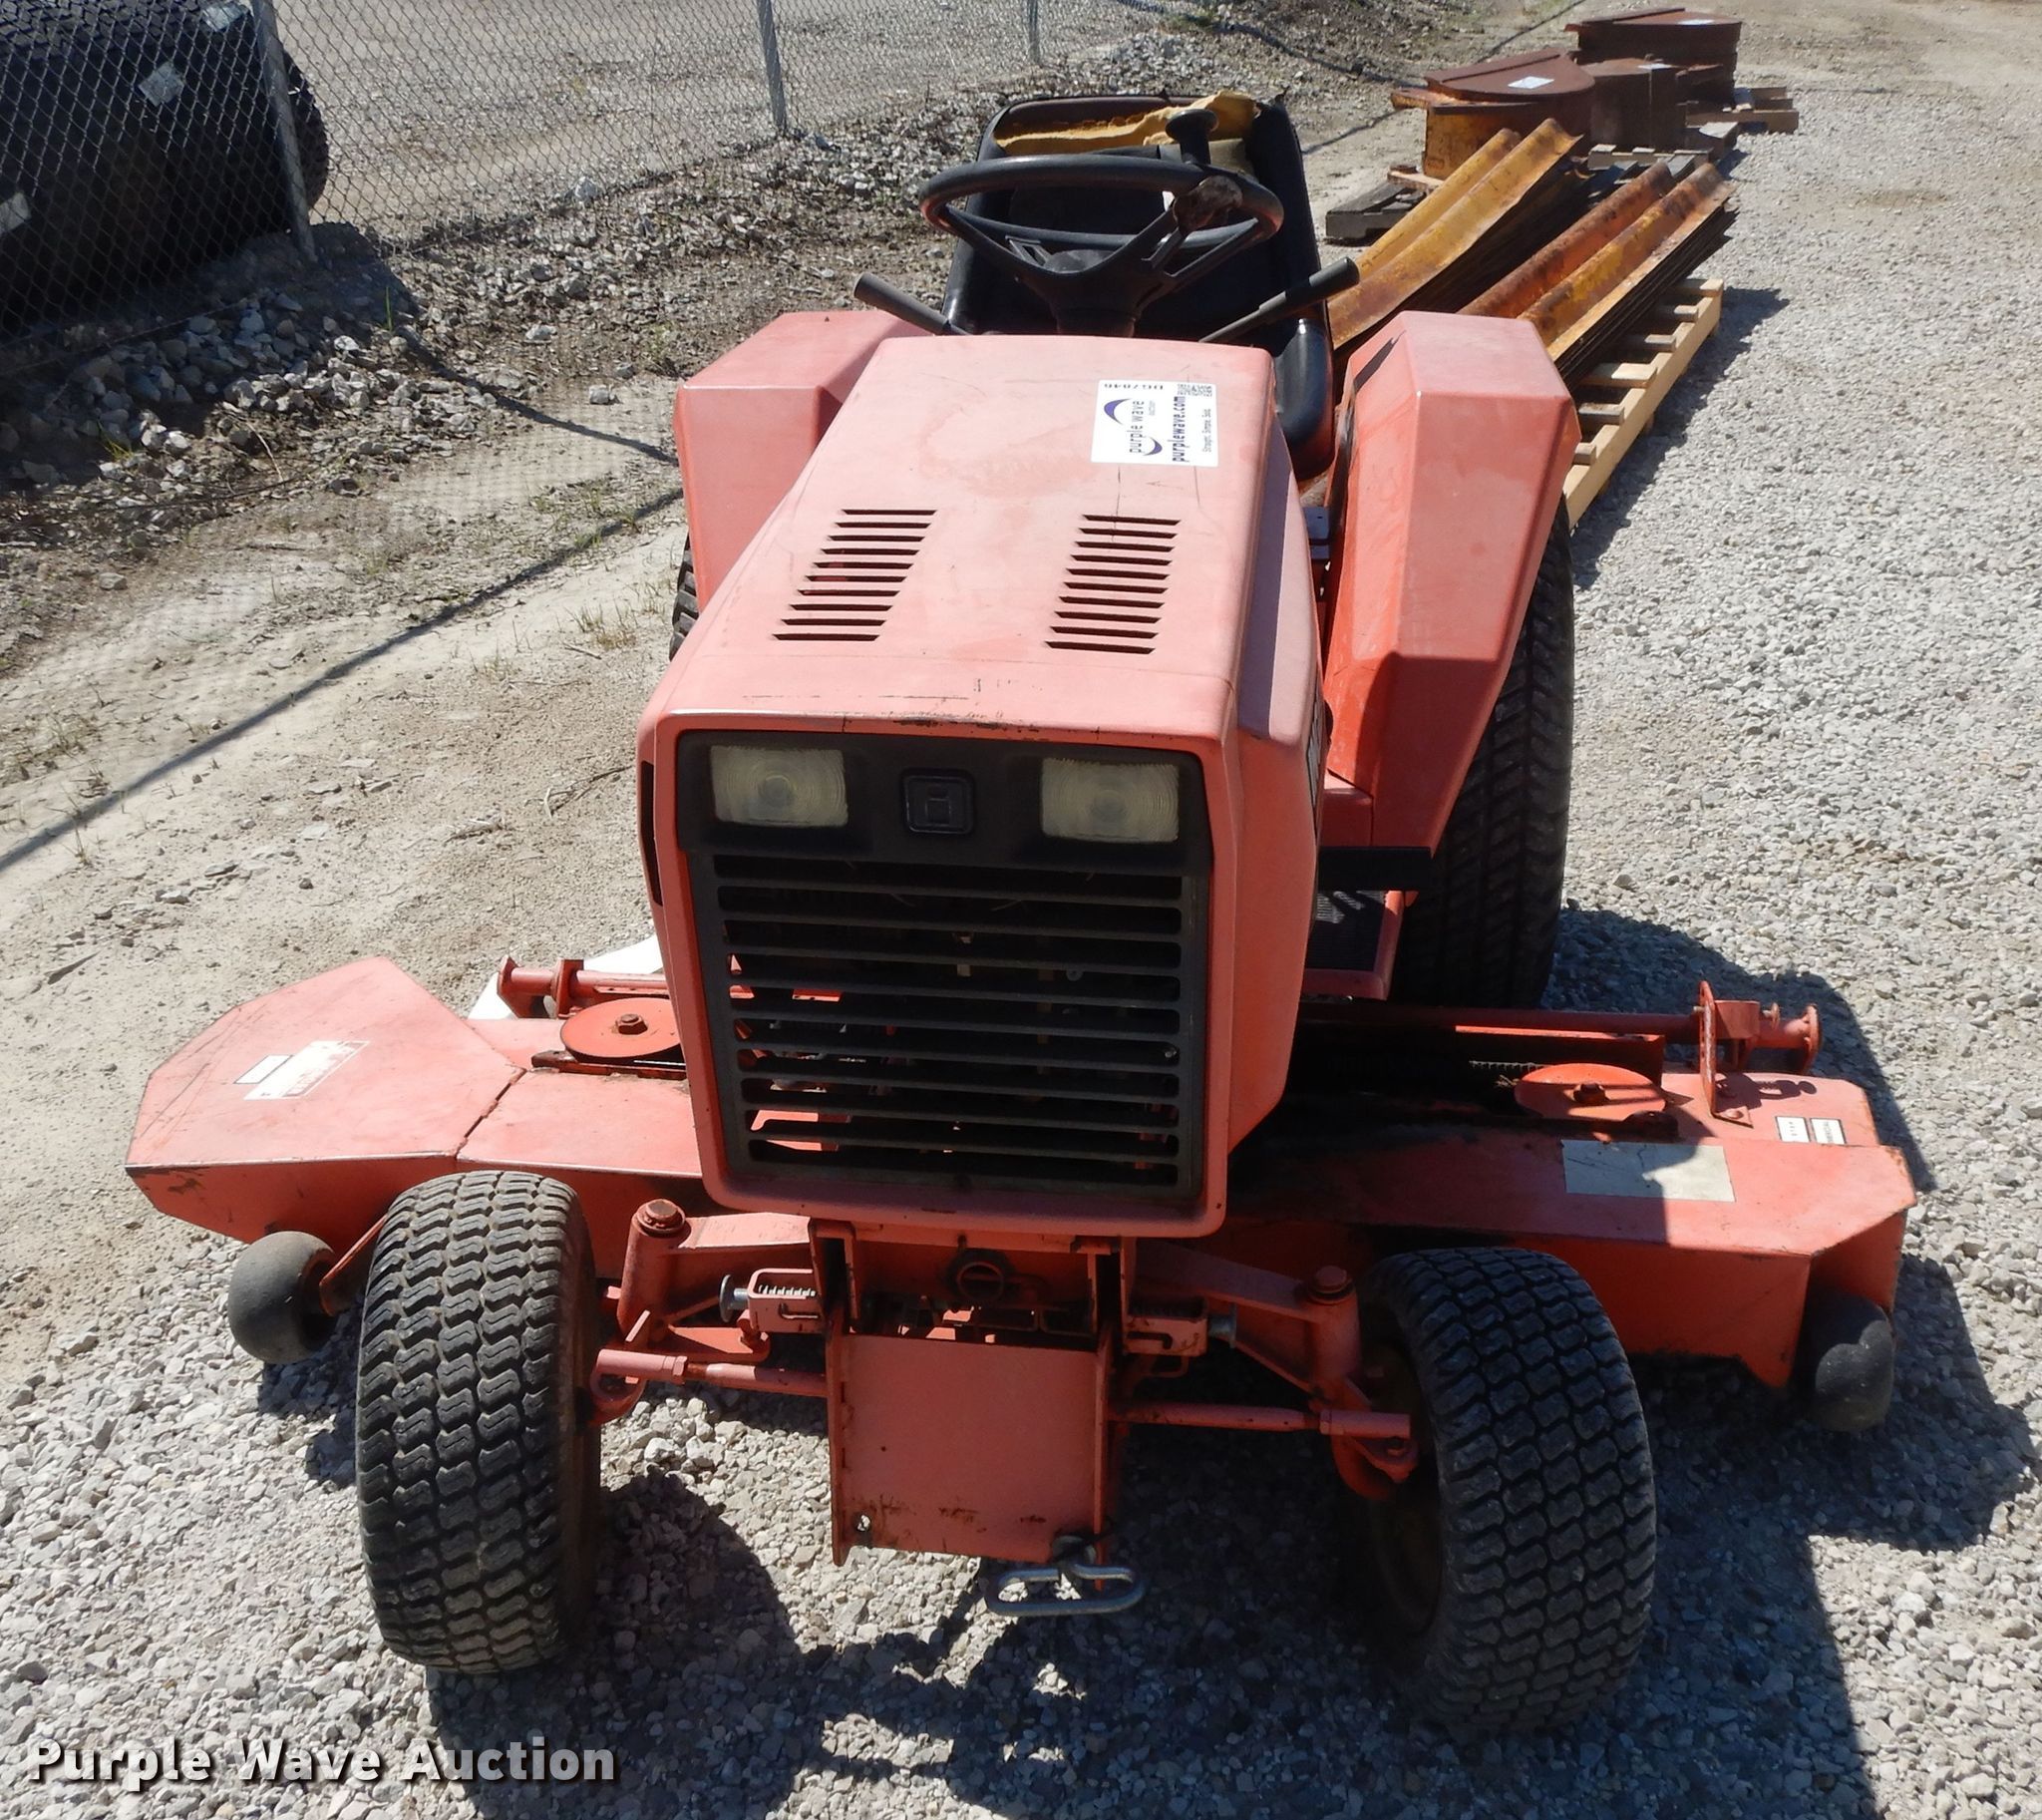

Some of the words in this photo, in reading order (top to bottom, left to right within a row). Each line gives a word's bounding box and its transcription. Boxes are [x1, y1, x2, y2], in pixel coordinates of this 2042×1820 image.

[1132, 401, 1145, 423] wave
[1127, 425, 1147, 454] purple
[1168, 396, 1191, 463] purplewave.com
